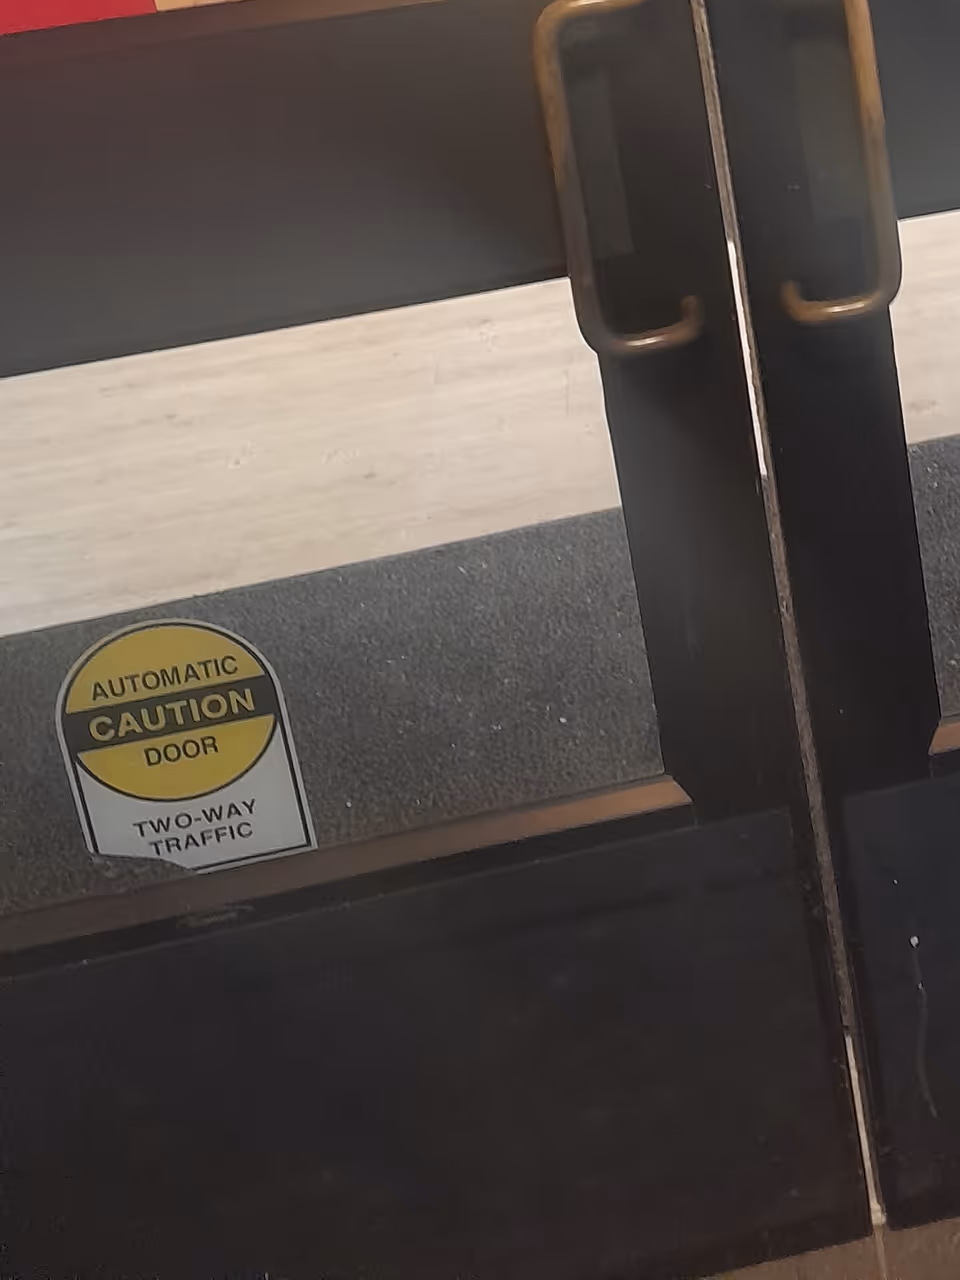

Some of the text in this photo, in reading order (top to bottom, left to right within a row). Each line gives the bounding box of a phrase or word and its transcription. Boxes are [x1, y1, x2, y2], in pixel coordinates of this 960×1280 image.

[91, 655, 239, 701] AUTOMATIC
[88, 688, 255, 742] CAUTION
[144, 735, 219, 766] DOOR
[132, 799, 256, 838] TWO-WAY
[149, 812, 254, 857] TRAFFIC
